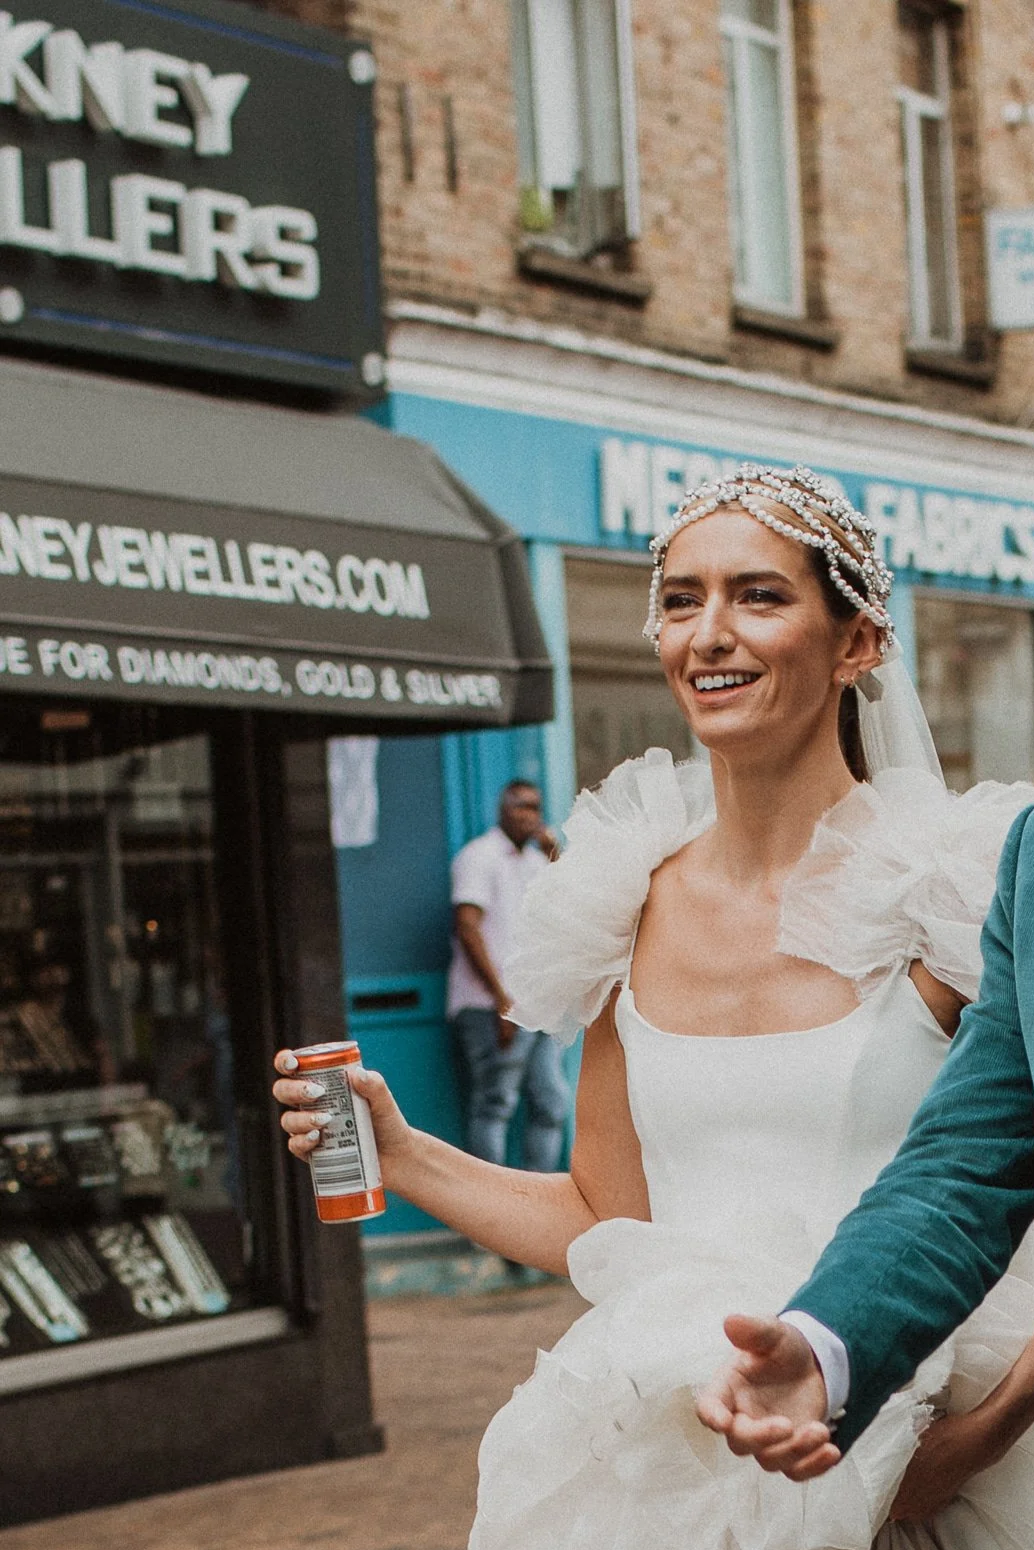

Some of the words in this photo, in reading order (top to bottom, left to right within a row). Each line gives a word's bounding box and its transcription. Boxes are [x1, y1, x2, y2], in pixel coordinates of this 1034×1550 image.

[0, 10, 249, 156] KNEY
[0, 145, 320, 300] LLERS
[38, 638, 114, 682] FOR
[117, 646, 293, 699] DIAMONDS,
[295, 659, 376, 700] GOLD
[380, 666, 403, 702] &
[404, 669, 504, 709] SILVER
